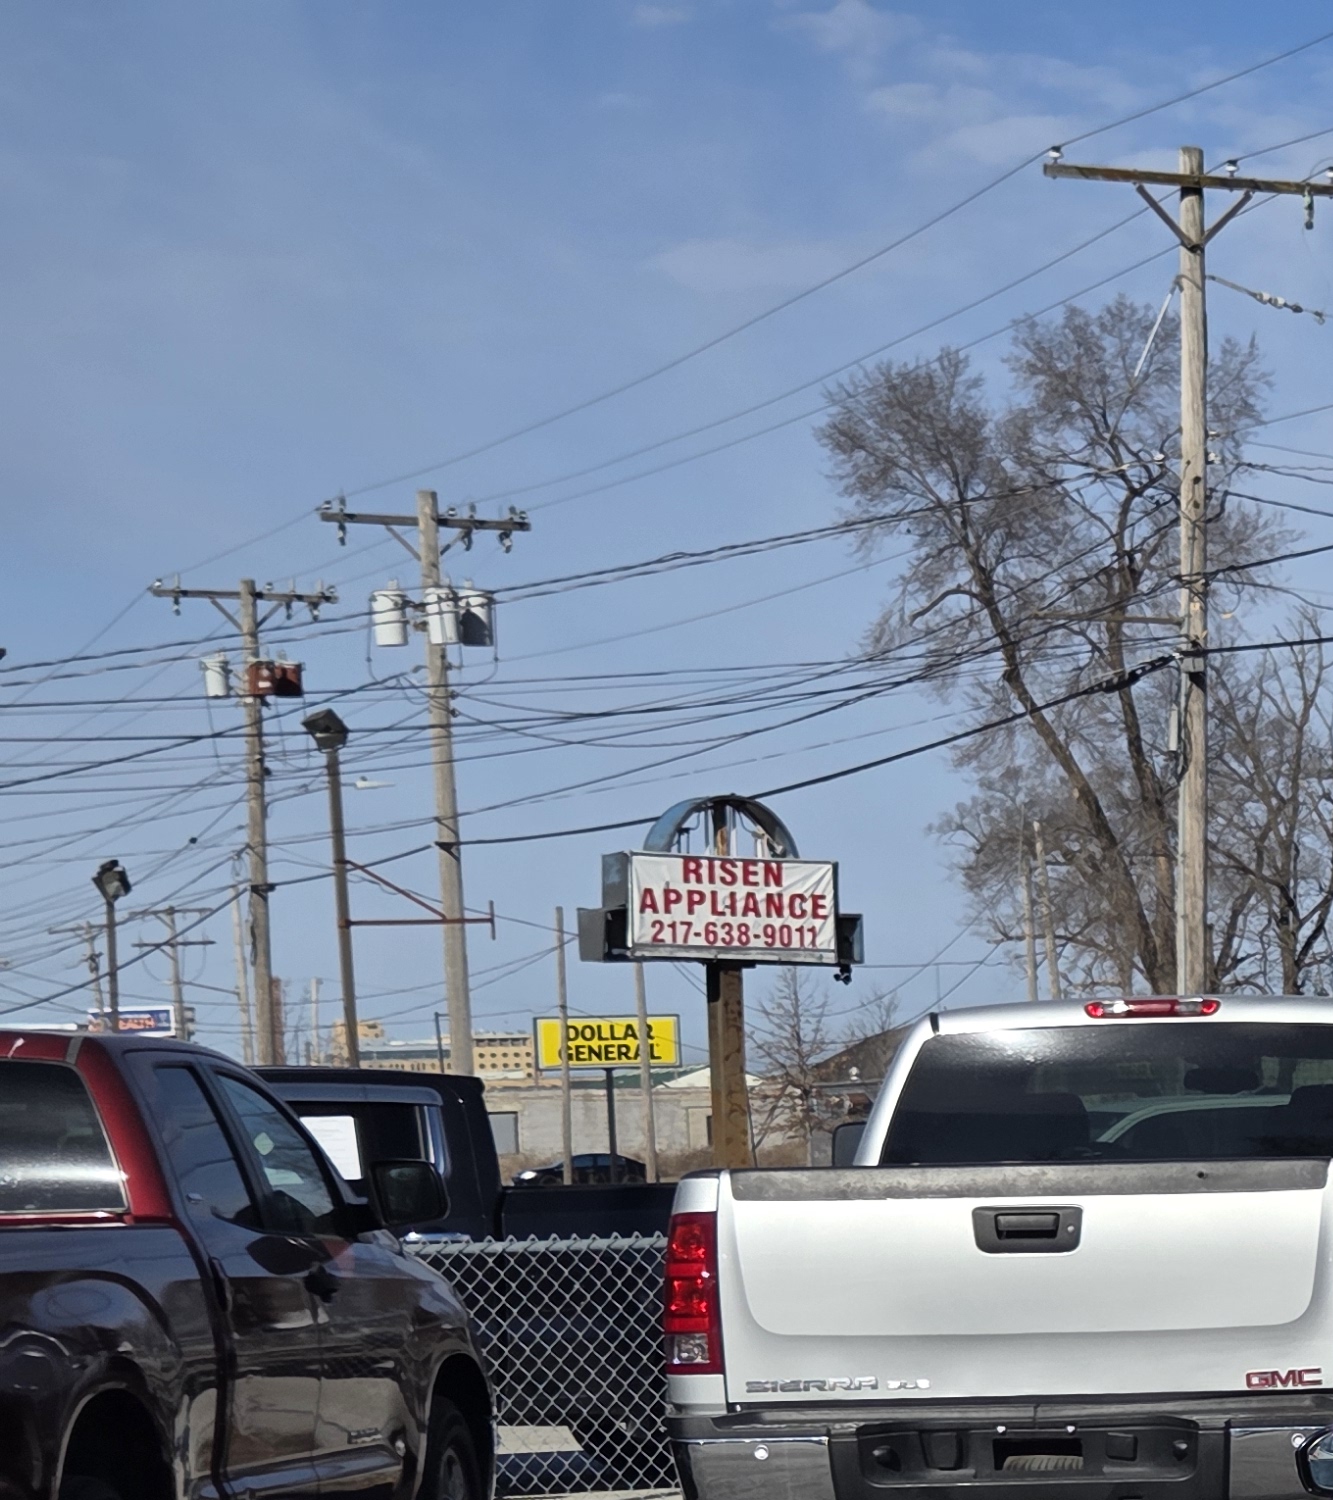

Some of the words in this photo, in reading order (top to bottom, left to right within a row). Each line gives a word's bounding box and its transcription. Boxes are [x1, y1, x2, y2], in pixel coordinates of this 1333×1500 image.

[682, 857, 784, 888] RISEN
[639, 887, 829, 920] APPLIANCE
[651, 919, 818, 949] 217-638-9011
[746, 1376, 879, 1393] SIERRA
[1246, 1368, 1323, 1389] GMC
